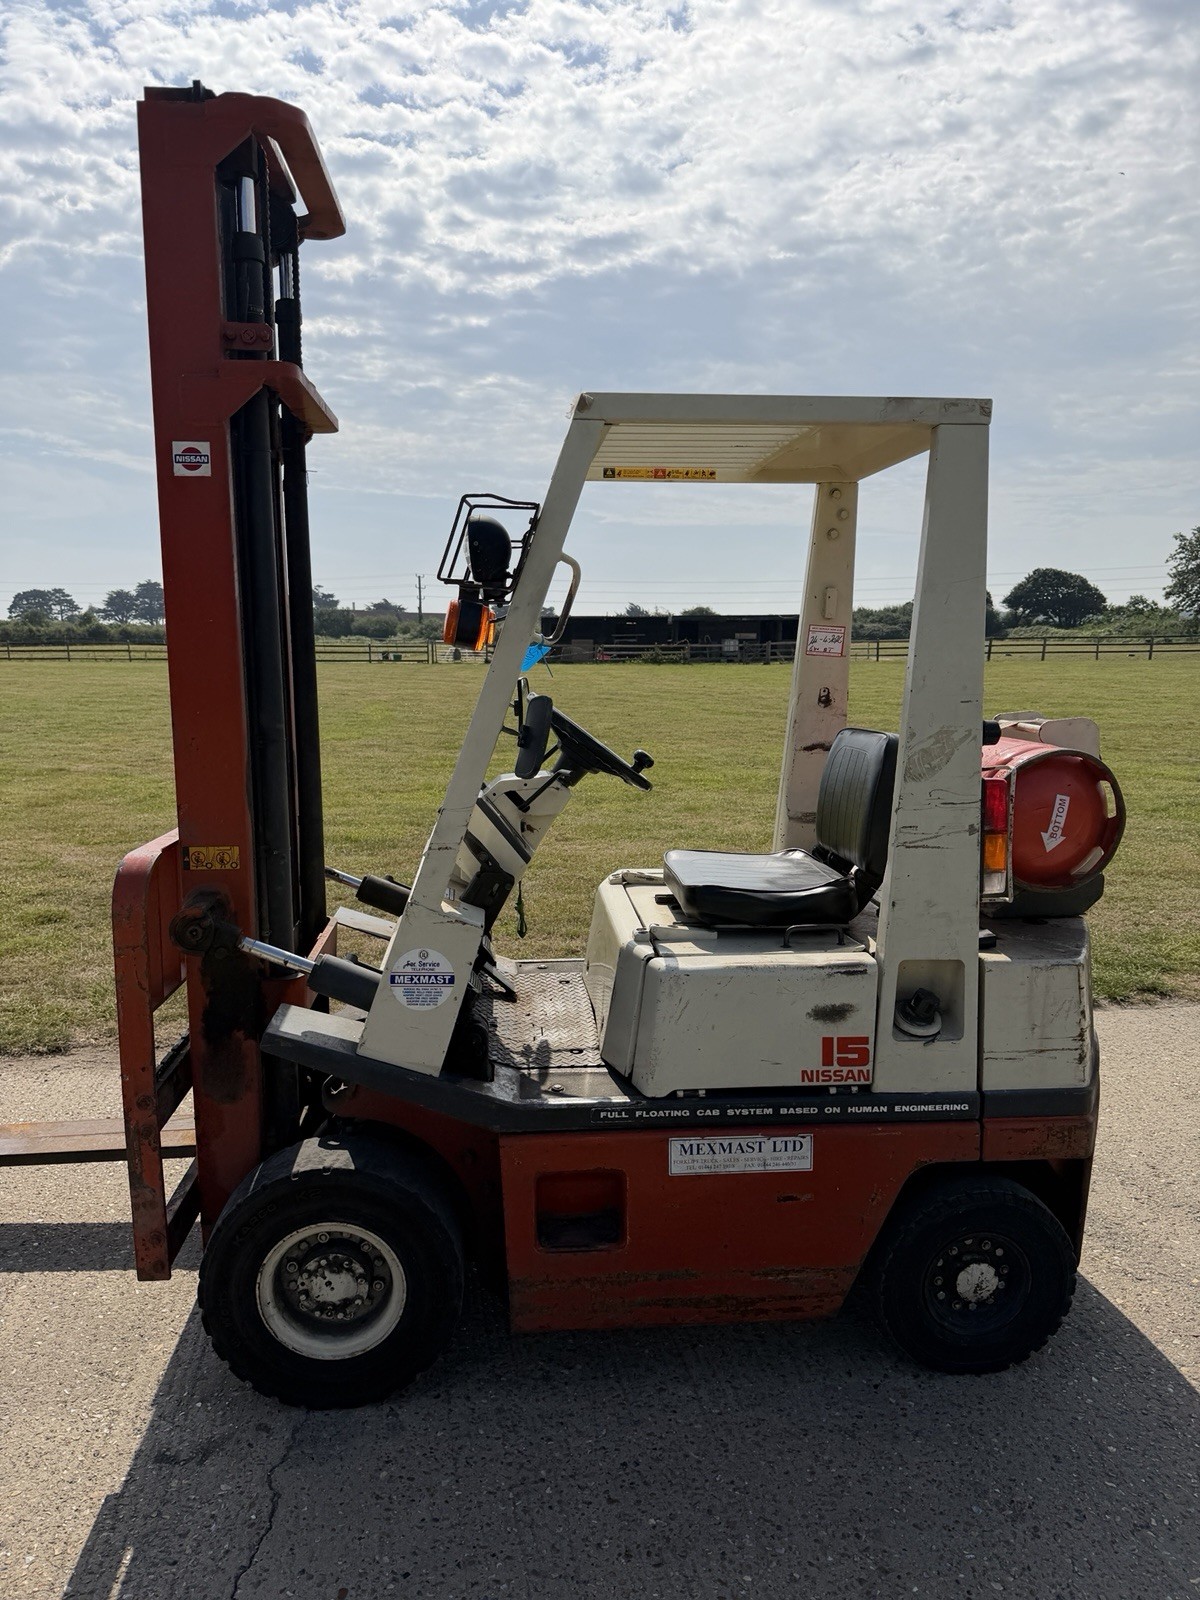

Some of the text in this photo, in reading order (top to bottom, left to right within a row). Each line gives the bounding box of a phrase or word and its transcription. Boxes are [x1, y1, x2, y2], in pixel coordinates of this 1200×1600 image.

[176, 455, 208, 463] NISSAN
[1050, 798, 1067, 839] BOTTOM
[403, 961, 416, 969] For
[394, 975, 451, 984] MEXMAST
[822, 1036, 870, 1067] 15
[801, 1069, 871, 1083] NISSAN
[600, 1111, 629, 1119] FULL
[635, 1110, 690, 1118] FLOATING
[726, 1108, 773, 1116] SYSTEM
[780, 1107, 819, 1115] BASED
[824, 1106, 841, 1114] ON
[847, 1106, 888, 1114] HUMAN
[894, 1103, 970, 1112] ENGINEERING
[679, 1139, 804, 1156] MEXMAST LTD
